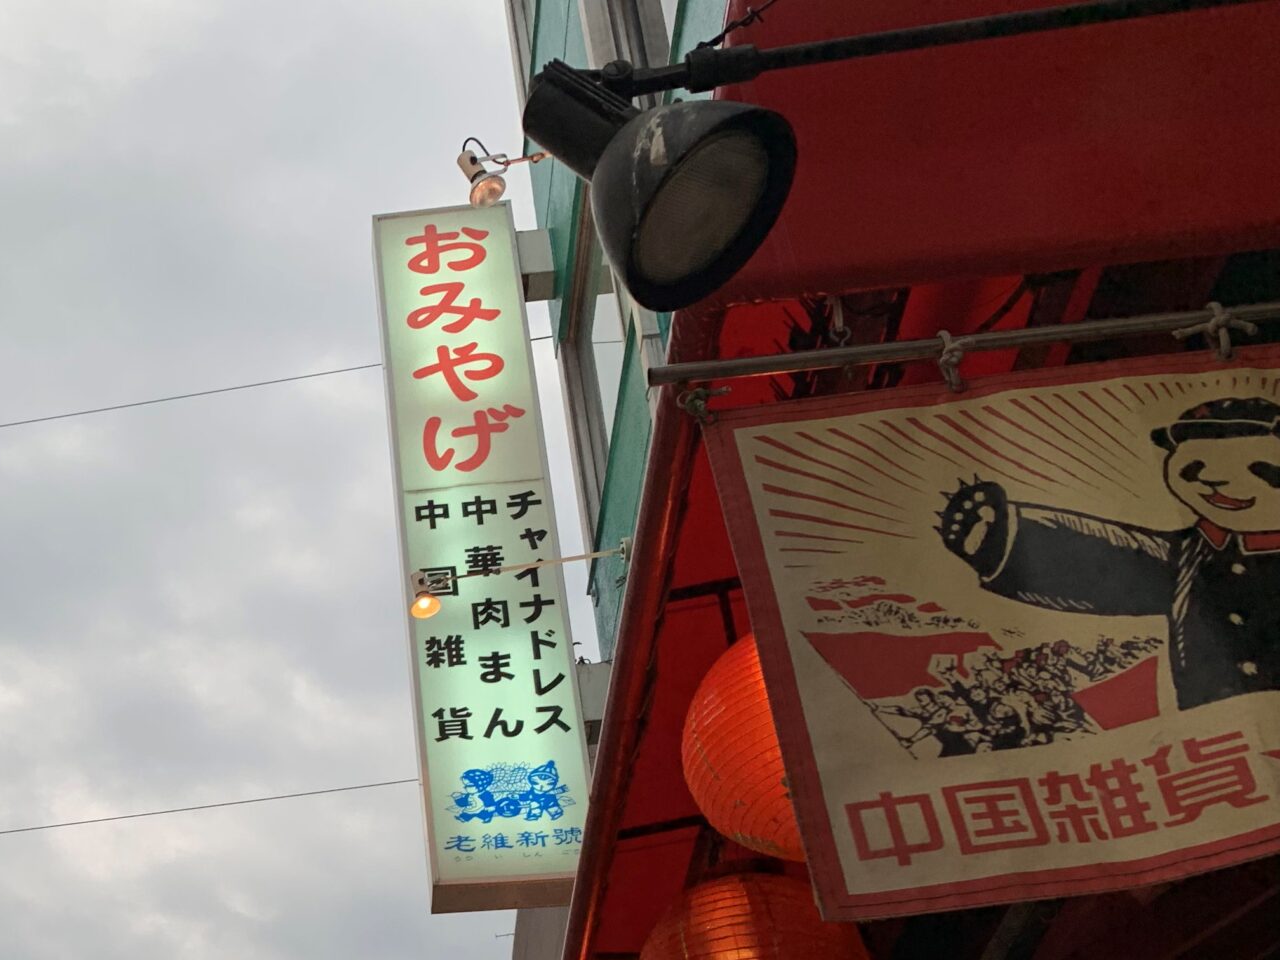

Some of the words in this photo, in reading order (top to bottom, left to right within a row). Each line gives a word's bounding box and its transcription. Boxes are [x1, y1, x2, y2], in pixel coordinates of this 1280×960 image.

[405, 224, 526, 472] おみやげ
[414, 500, 473, 742] 中国雑貨
[461, 495, 524, 739] 中華肉まん
[506, 490, 571, 735] チャイナドレス
[844, 730, 1269, 867] 中国雑貨
